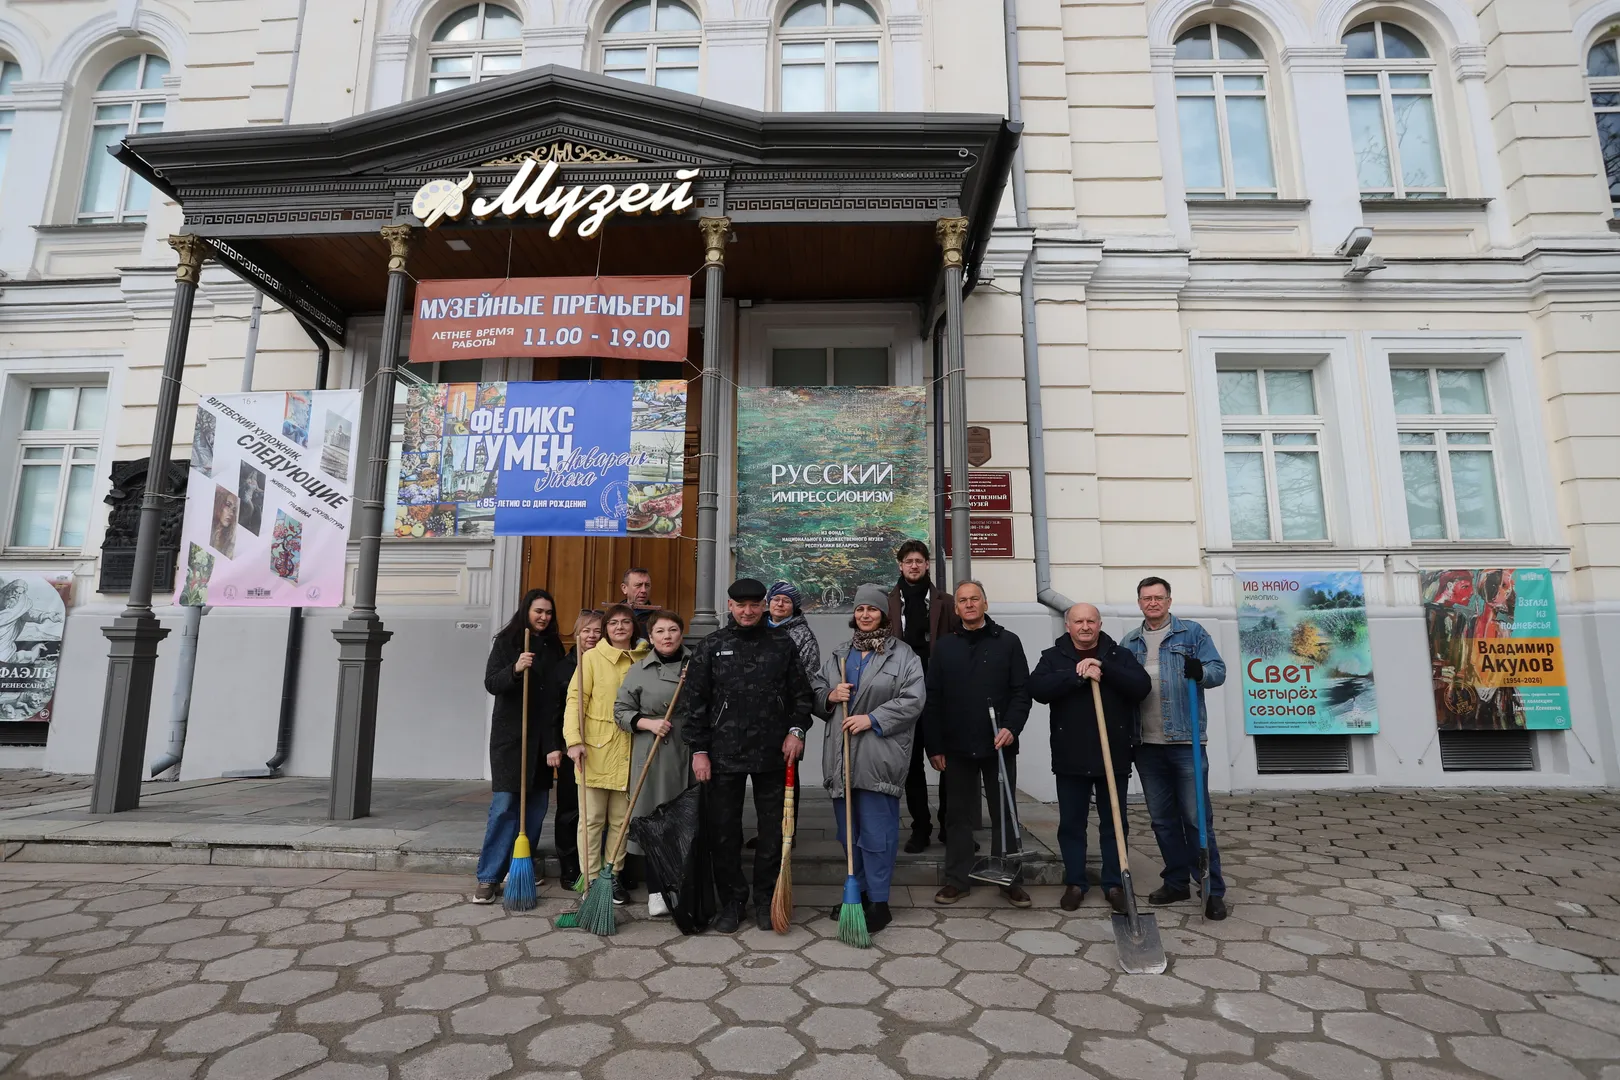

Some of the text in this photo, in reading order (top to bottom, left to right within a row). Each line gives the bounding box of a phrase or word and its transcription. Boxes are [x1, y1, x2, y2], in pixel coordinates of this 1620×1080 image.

[471, 157, 700, 238] Музей
[420, 293, 684, 319] МУЗЕЙНЫЕ ПРЕМЬЕРЫ
[432, 327, 514, 340] ЛЕТНЕЕ ВРЕМЯ
[523, 327, 582, 346] 11.00
[609, 328, 670, 349] 19.00
[452, 338, 496, 349] РАБОТЫ
[206, 396, 302, 461] ВИТЕБСКИЙ ХУДОЖНИК.
[470, 406, 575, 434] ФЕЛИКС
[465, 434, 573, 471] ГУМЕН
[556, 446, 649, 476] Акварель
[236, 434, 349, 509] СЛЕДУЮЩИЕ
[534, 466, 598, 493] Эпоха
[771, 462, 894, 485] РУССКИЙ
[483, 498, 520, 508] 85-ЛЕТИЮ
[533, 500, 548, 509] ДНЯ
[549, 500, 587, 509] РОЖДЕНИЯ
[771, 491, 894, 503] ИМПРЕССИОНИЗМ
[287, 501, 312, 518] ГРАФИКА
[1242, 579, 1300, 592] ИВ ЖАЙО
[1518, 597, 1548, 607] Взгляд
[1501, 622, 1551, 630] поднебесья
[1478, 641, 1554, 656] Владимир
[0, 667, 51, 679] ФАЭЛЬ
[1247, 658, 1315, 683] Свет
[1481, 655, 1554, 676] Акулов
[1248, 686, 1318, 703] четырёх
[1249, 705, 1316, 716] сезонов
